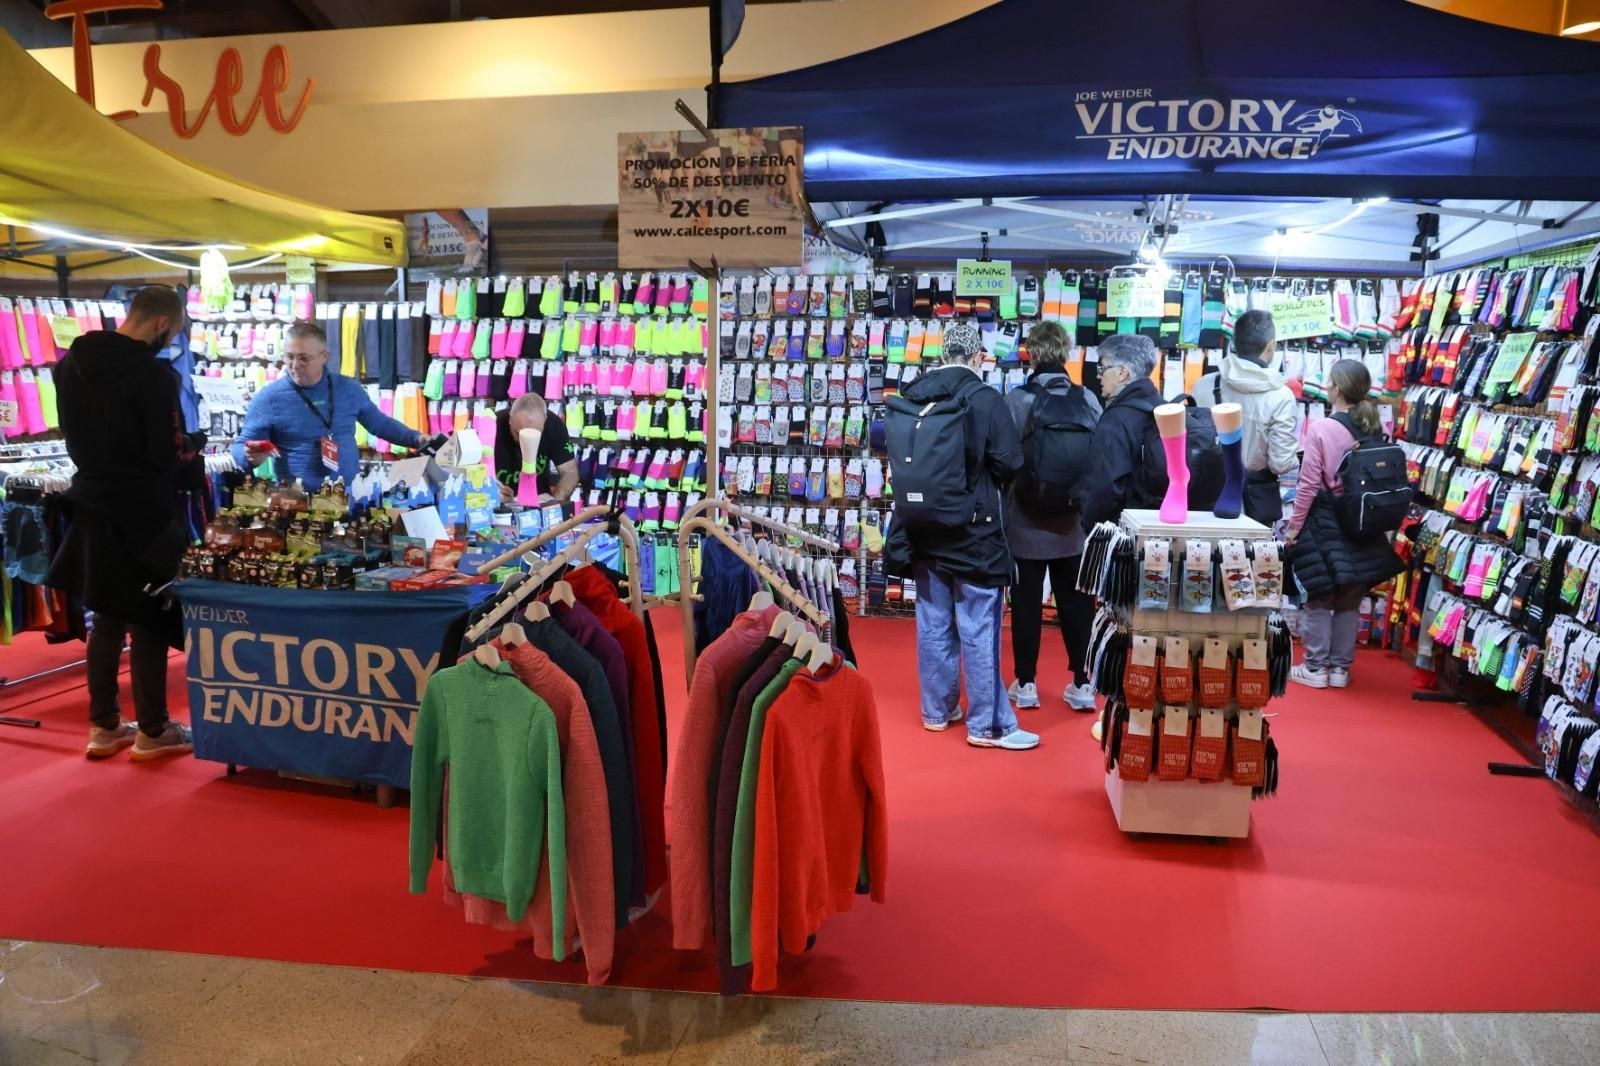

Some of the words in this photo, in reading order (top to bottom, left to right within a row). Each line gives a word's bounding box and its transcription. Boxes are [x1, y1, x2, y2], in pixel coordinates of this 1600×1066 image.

[1075, 91, 1098, 102] JOE
[1101, 88, 1153, 100] WEIDER
[1075, 98, 1297, 135] VICTORY
[1106, 136, 1313, 160] ENDURANCE
[625, 154, 721, 171] PROMOCIÓN
[725, 156, 745, 169] DE
[751, 155, 796, 167] FERIA
[634, 177, 667, 189] 50%
[669, 176, 689, 188] DE
[693, 174, 787, 188] DESCUENTO
[670, 198, 750, 219] 2X10€
[633, 225, 787, 239] www.calcesport.com
[962, 266, 1006, 276] RUNNING
[966, 280, 972, 288] 2
[987, 280, 1003, 288] 10€
[1281, 325, 1288, 334] 2
[183, 605, 249, 625] WEIDER
[202, 687, 418, 746] ENDURAN
